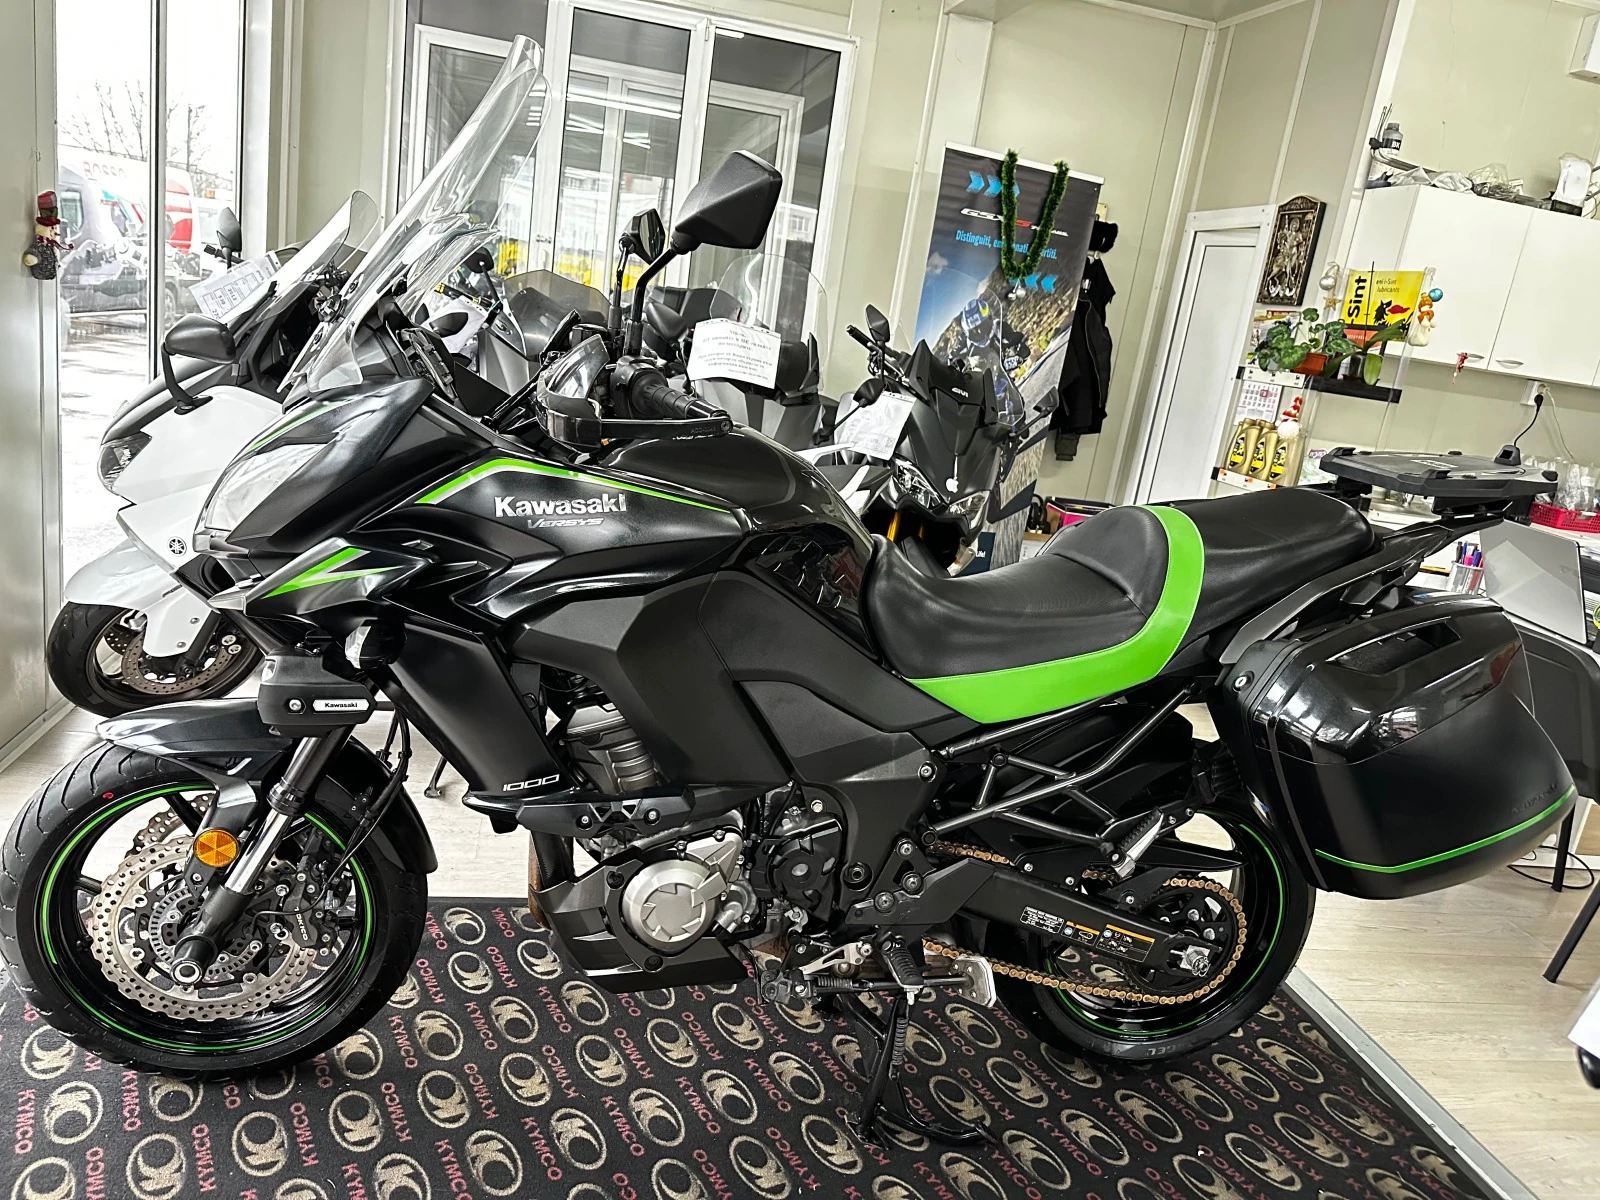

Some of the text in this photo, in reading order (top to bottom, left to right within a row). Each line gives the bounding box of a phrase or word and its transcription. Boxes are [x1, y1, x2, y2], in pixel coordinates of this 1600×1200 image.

[955, 230, 992, 248] Distinguiti,
[951, 387, 969, 398] GIVI
[493, 492, 628, 519] Kawasaki
[526, 517, 606, 529] VERSYS
[324, 701, 358, 709] Kawasaki
[502, 773, 561, 792] 1000
[416, 959, 446, 1005] KYMCO
[486, 945, 519, 990] KYMCO
[467, 1001, 498, 1050] KYMCO
[537, 985, 573, 1033] KYMCO
[744, 995, 789, 1045] KYMCO
[923, 1008, 976, 1056] KYMCO
[388, 1016, 418, 1069] KYMCO
[613, 1027, 655, 1079] KYMCO
[681, 1011, 724, 1060] KYMCO
[312, 1053, 333, 1088] MCO
[464, 1063, 499, 1119] KYMCO
[541, 1045, 580, 1098] KYMCO
[744, 1059, 792, 1112] KYMCO
[807, 1041, 858, 1093] KYMCO
[1012, 1049, 1073, 1100] KYMCO
[1192, 1062, 1259, 1111] KYMCO
[1238, 1043, 1304, 1092] KYMCO
[381, 1082, 413, 1142] KYMCO
[675, 1076, 721, 1135] KYMCO
[957, 1067, 1016, 1121] KYMCO
[1143, 1080, 1210, 1131] KYMCO
[15, 1089, 35, 1154] KYMCO
[290, 1103, 320, 1167] KYMCO
[601, 1095, 645, 1157] KYMCO
[1036, 1118, 1102, 1176] KYMCO
[1092, 1097, 1159, 1153] KYMCO
[1295, 1104, 1370, 1158] KYMCO
[85, 1146, 105, 1200] MCO
[192, 1123, 216, 1192] KYMCO
[521, 1117, 563, 1180] KYMCO
[765, 1126, 821, 1190] KYMCO
[1248, 1123, 1324, 1181] KYMCO
